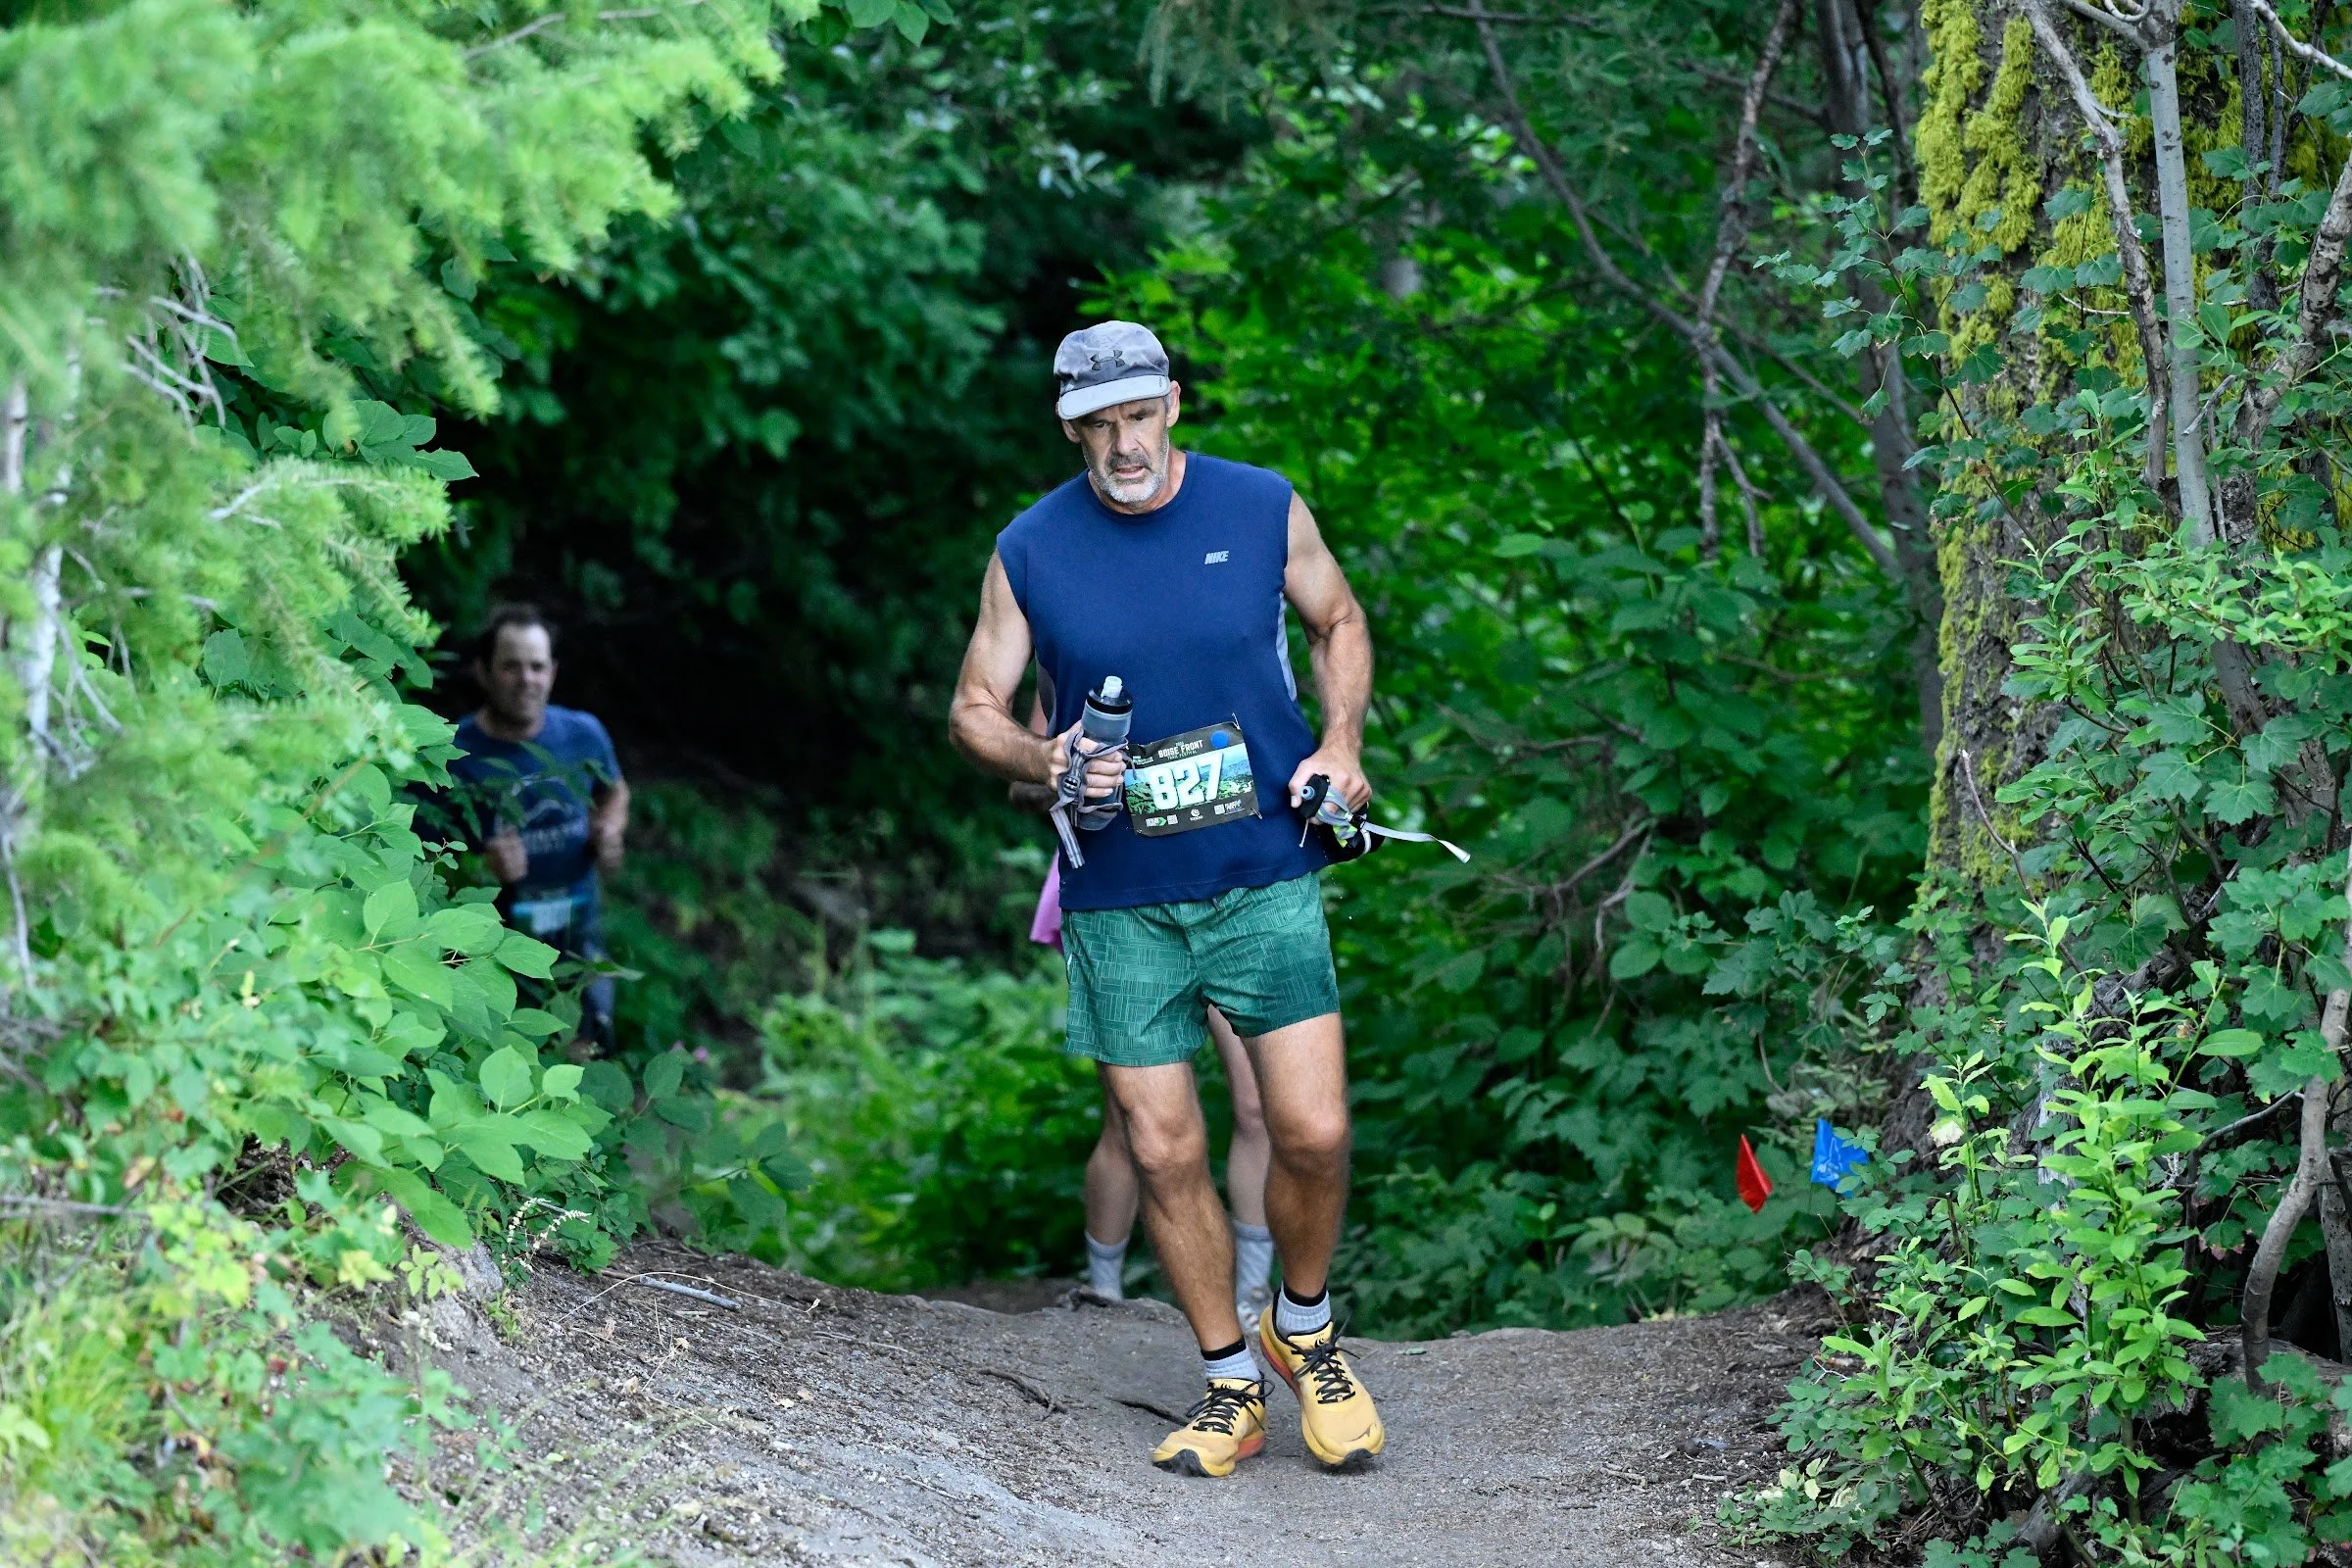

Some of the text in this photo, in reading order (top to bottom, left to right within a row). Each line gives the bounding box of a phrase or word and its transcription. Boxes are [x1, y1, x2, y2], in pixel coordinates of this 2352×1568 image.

[1204, 551, 1229, 564] NIKE
[1158, 746, 1180, 759] BOISE
[1180, 740, 1203, 753] FRONT
[1149, 752, 1224, 809] 827
